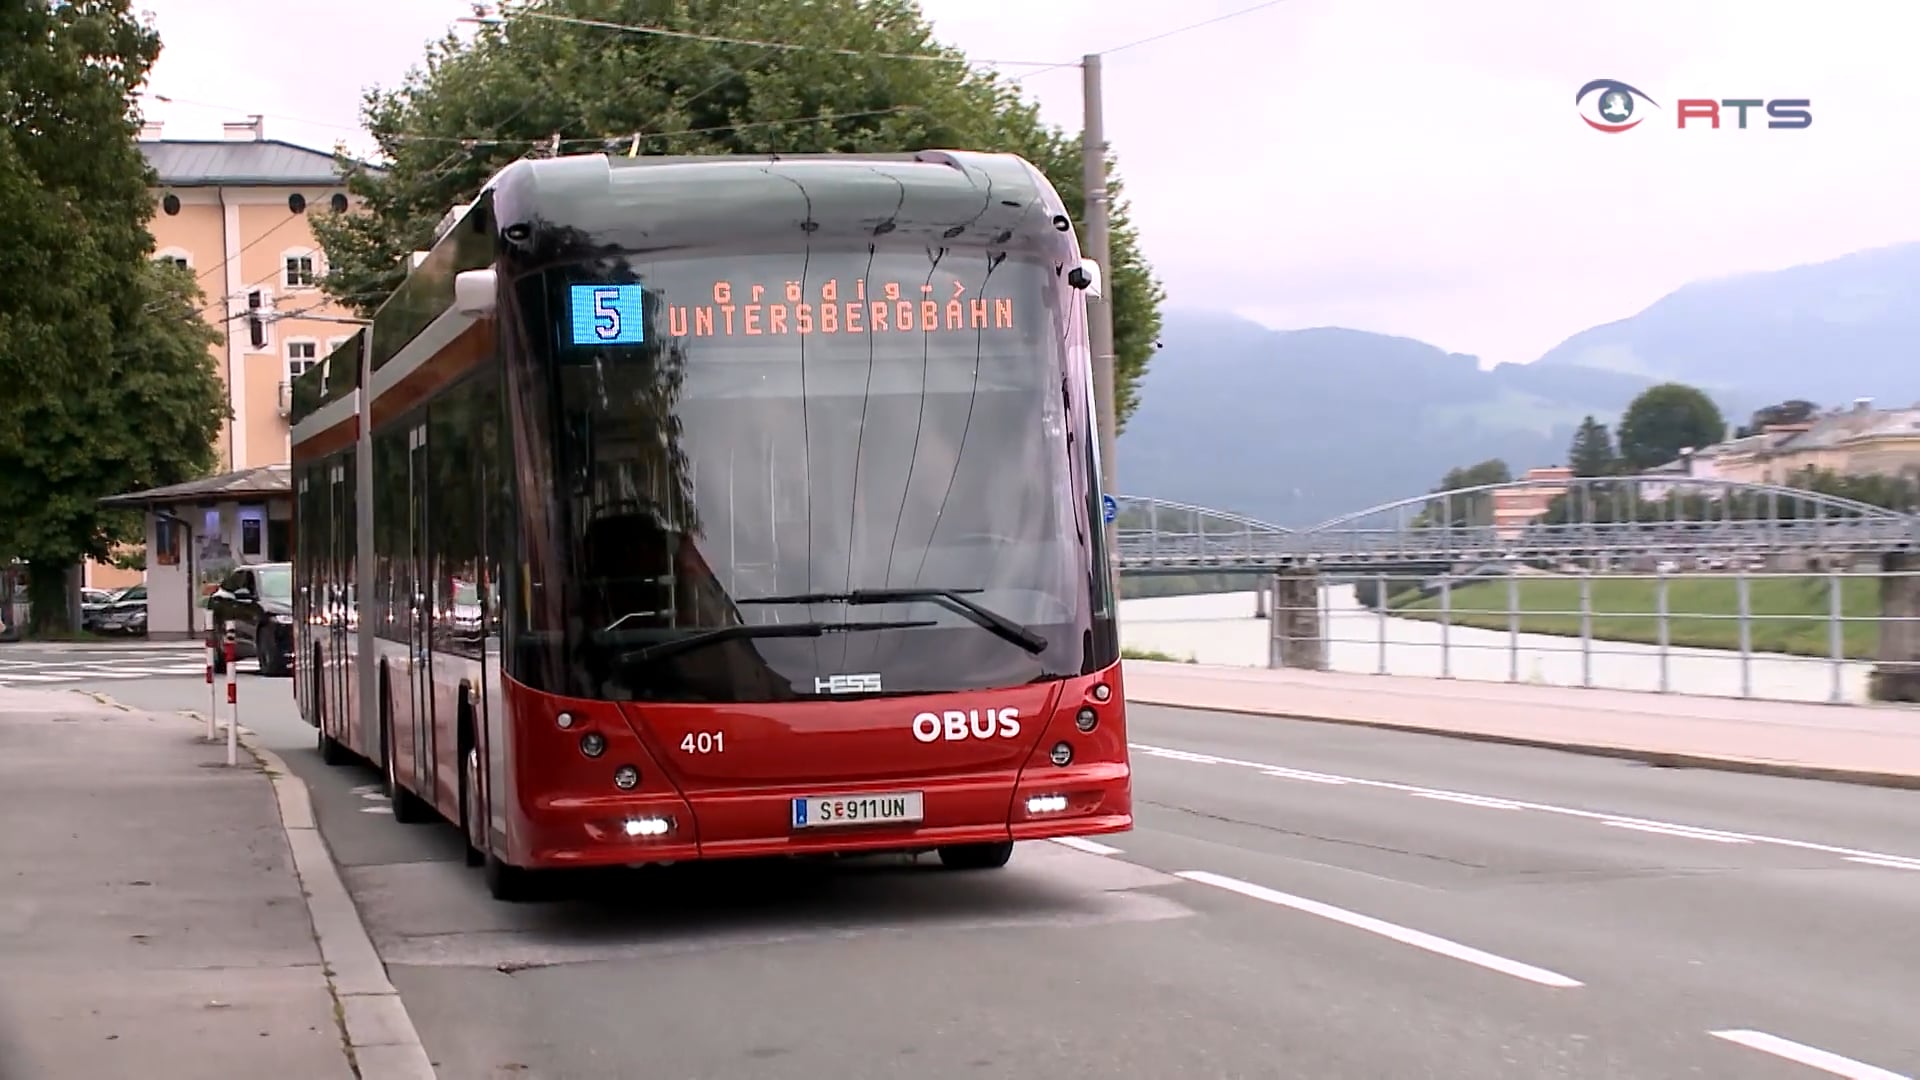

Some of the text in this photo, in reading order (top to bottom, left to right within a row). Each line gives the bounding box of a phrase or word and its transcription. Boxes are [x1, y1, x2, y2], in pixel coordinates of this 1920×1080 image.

[594, 289, 621, 340] 5
[669, 298, 1013, 337] UNTERSBERGBAHN
[814, 673, 882, 694] HESS
[680, 731, 725, 754] 401
[912, 708, 1021, 743] OBUS
